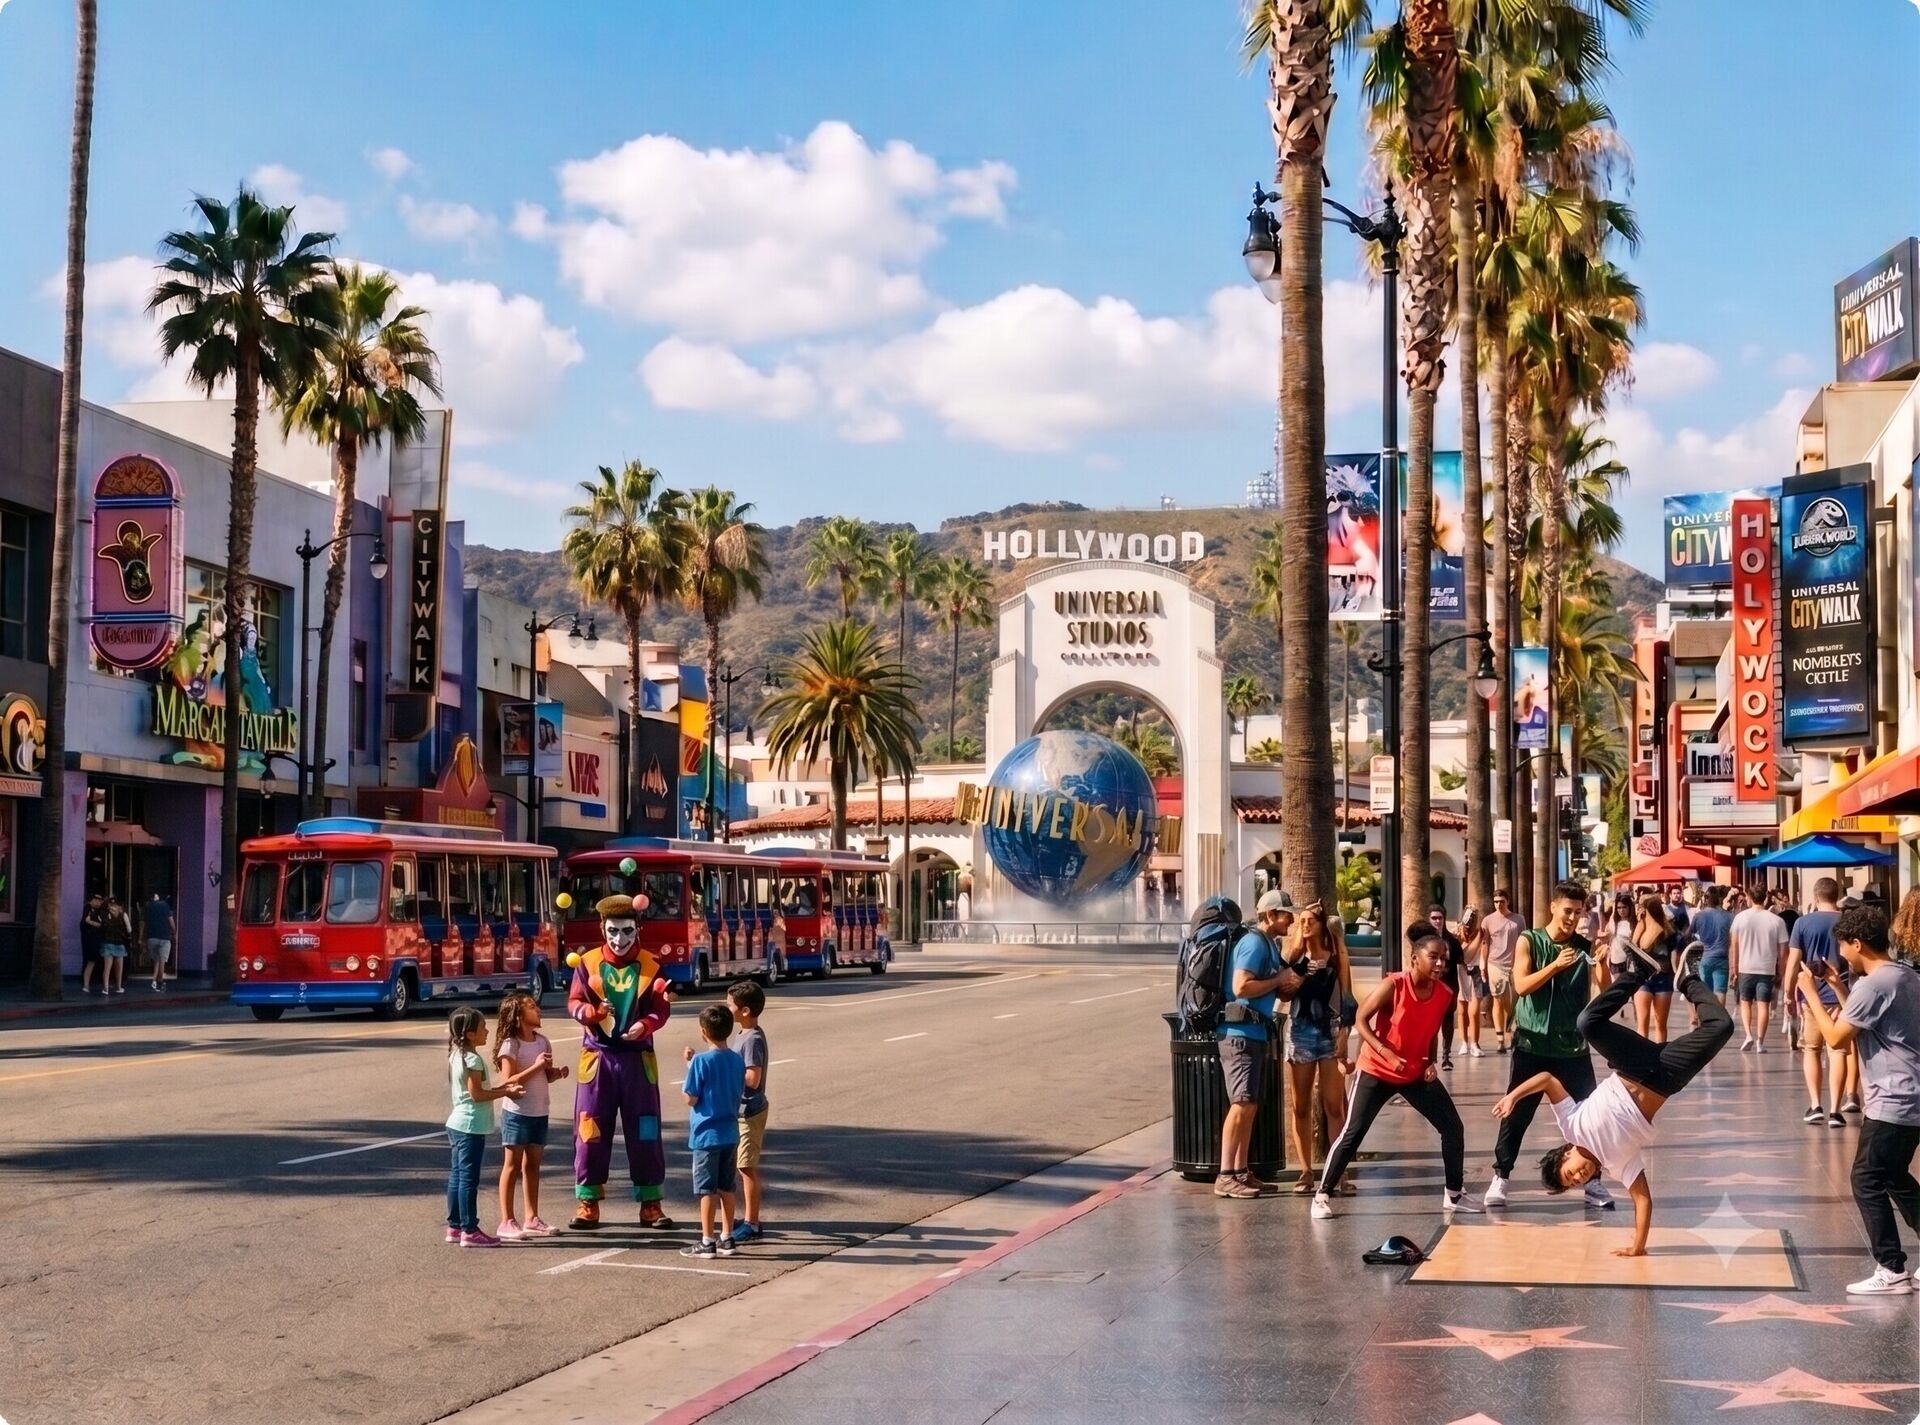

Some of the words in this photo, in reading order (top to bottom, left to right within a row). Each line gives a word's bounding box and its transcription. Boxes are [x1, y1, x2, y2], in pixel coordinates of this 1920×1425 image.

[1841, 286, 1904, 363] CITYWALK
[1671, 511, 1733, 527] UNIVER
[984, 529, 1204, 562] HOLLYWOOD
[1671, 526, 1733, 568] CITYW
[413, 517, 434, 684] CITYWALK
[1054, 590, 1160, 615] UNIVERSAL
[1791, 580, 1859, 598] UNIVERSAL
[1791, 594, 1861, 630] CITYWALK
[1067, 621, 1148, 645] STUDIOS
[1739, 513, 1769, 788] HOLYWOCK
[153, 684, 297, 755] MARGATAVILLE
